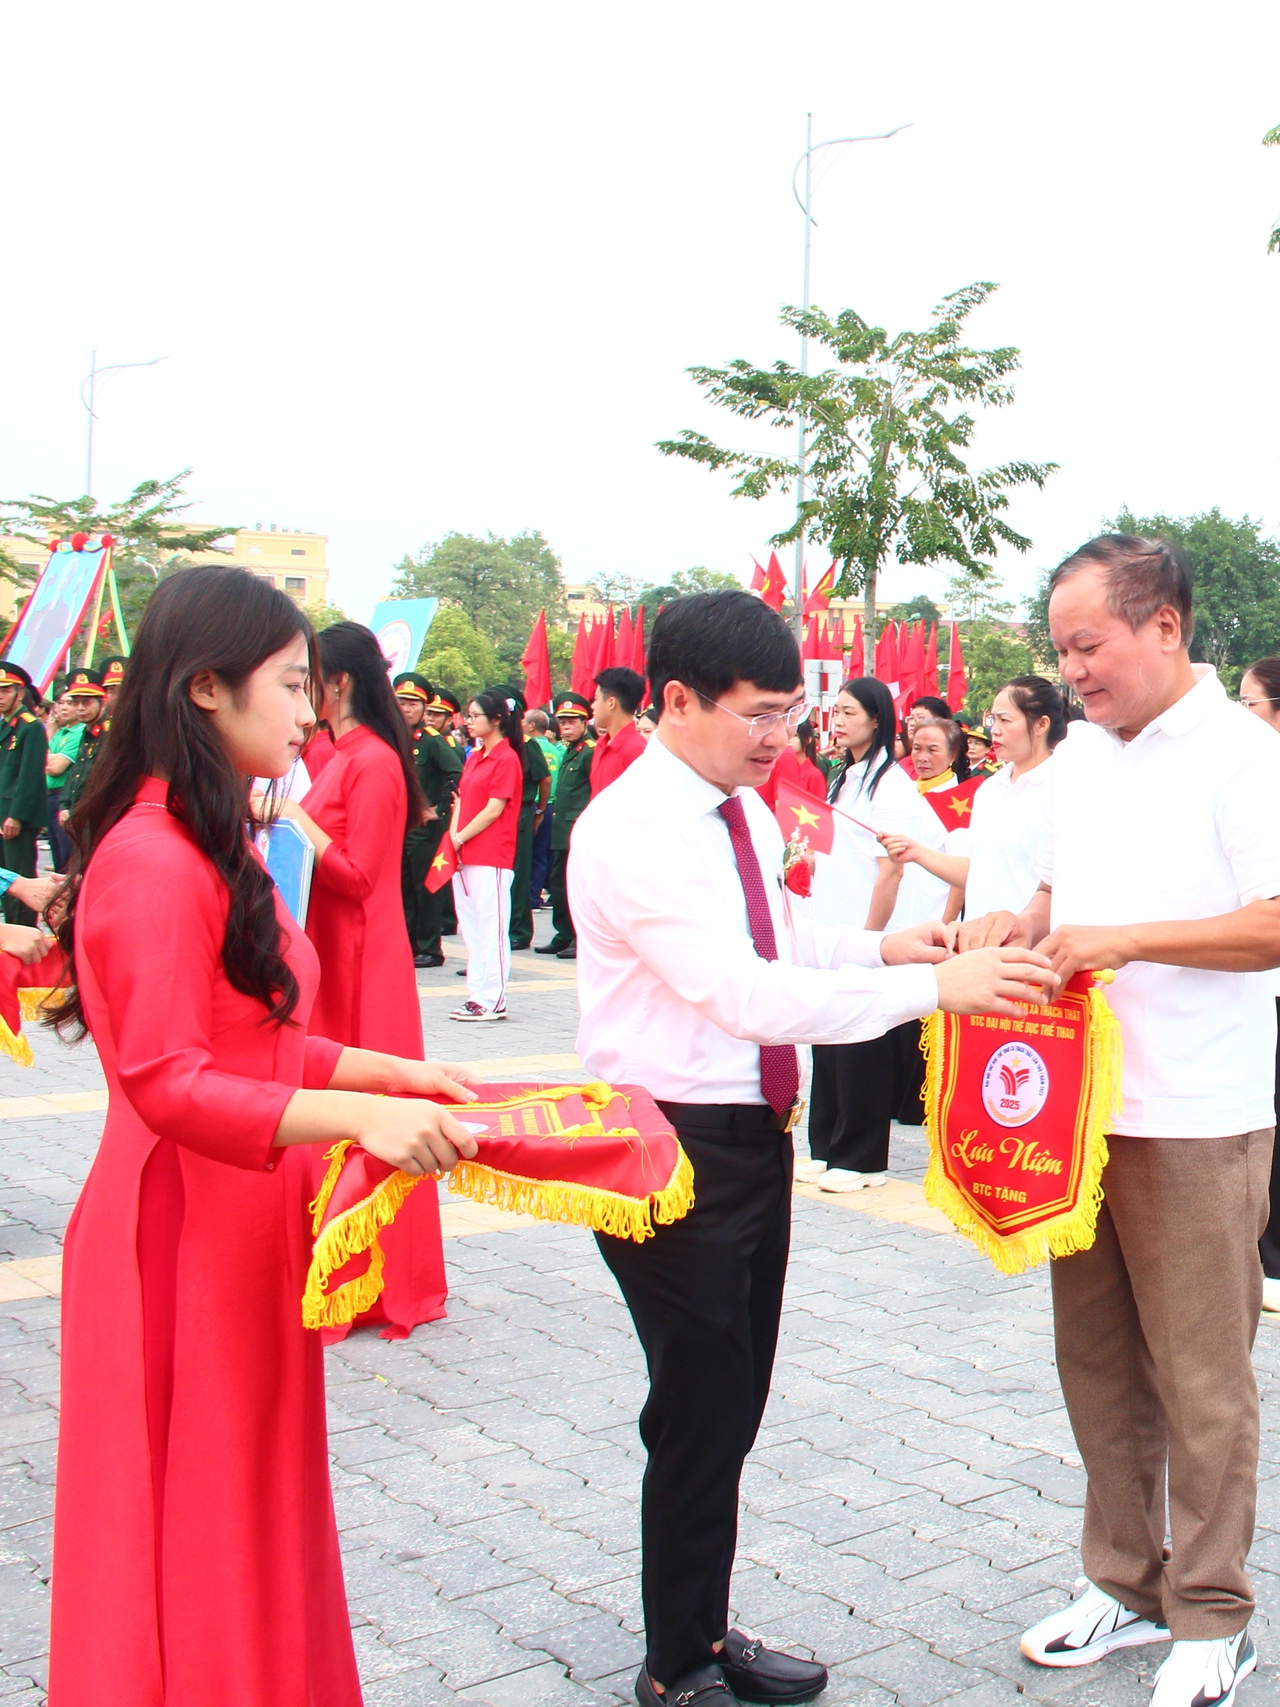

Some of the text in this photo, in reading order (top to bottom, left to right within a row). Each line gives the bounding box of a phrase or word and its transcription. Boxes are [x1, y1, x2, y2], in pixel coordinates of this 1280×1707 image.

[970, 1015, 985, 1026] BTC
[986, 1017, 999, 1031] ĐẠI
[999, 1016, 1011, 1032] HỘI
[1024, 1022, 1039, 1036] DỤC
[1056, 1026, 1075, 1040] THAO
[1000, 1098, 1020, 1110] 2025
[951, 1128, 1063, 1176] Lưu Niệm
[972, 1182, 1027, 1204] BTC TẶNG
